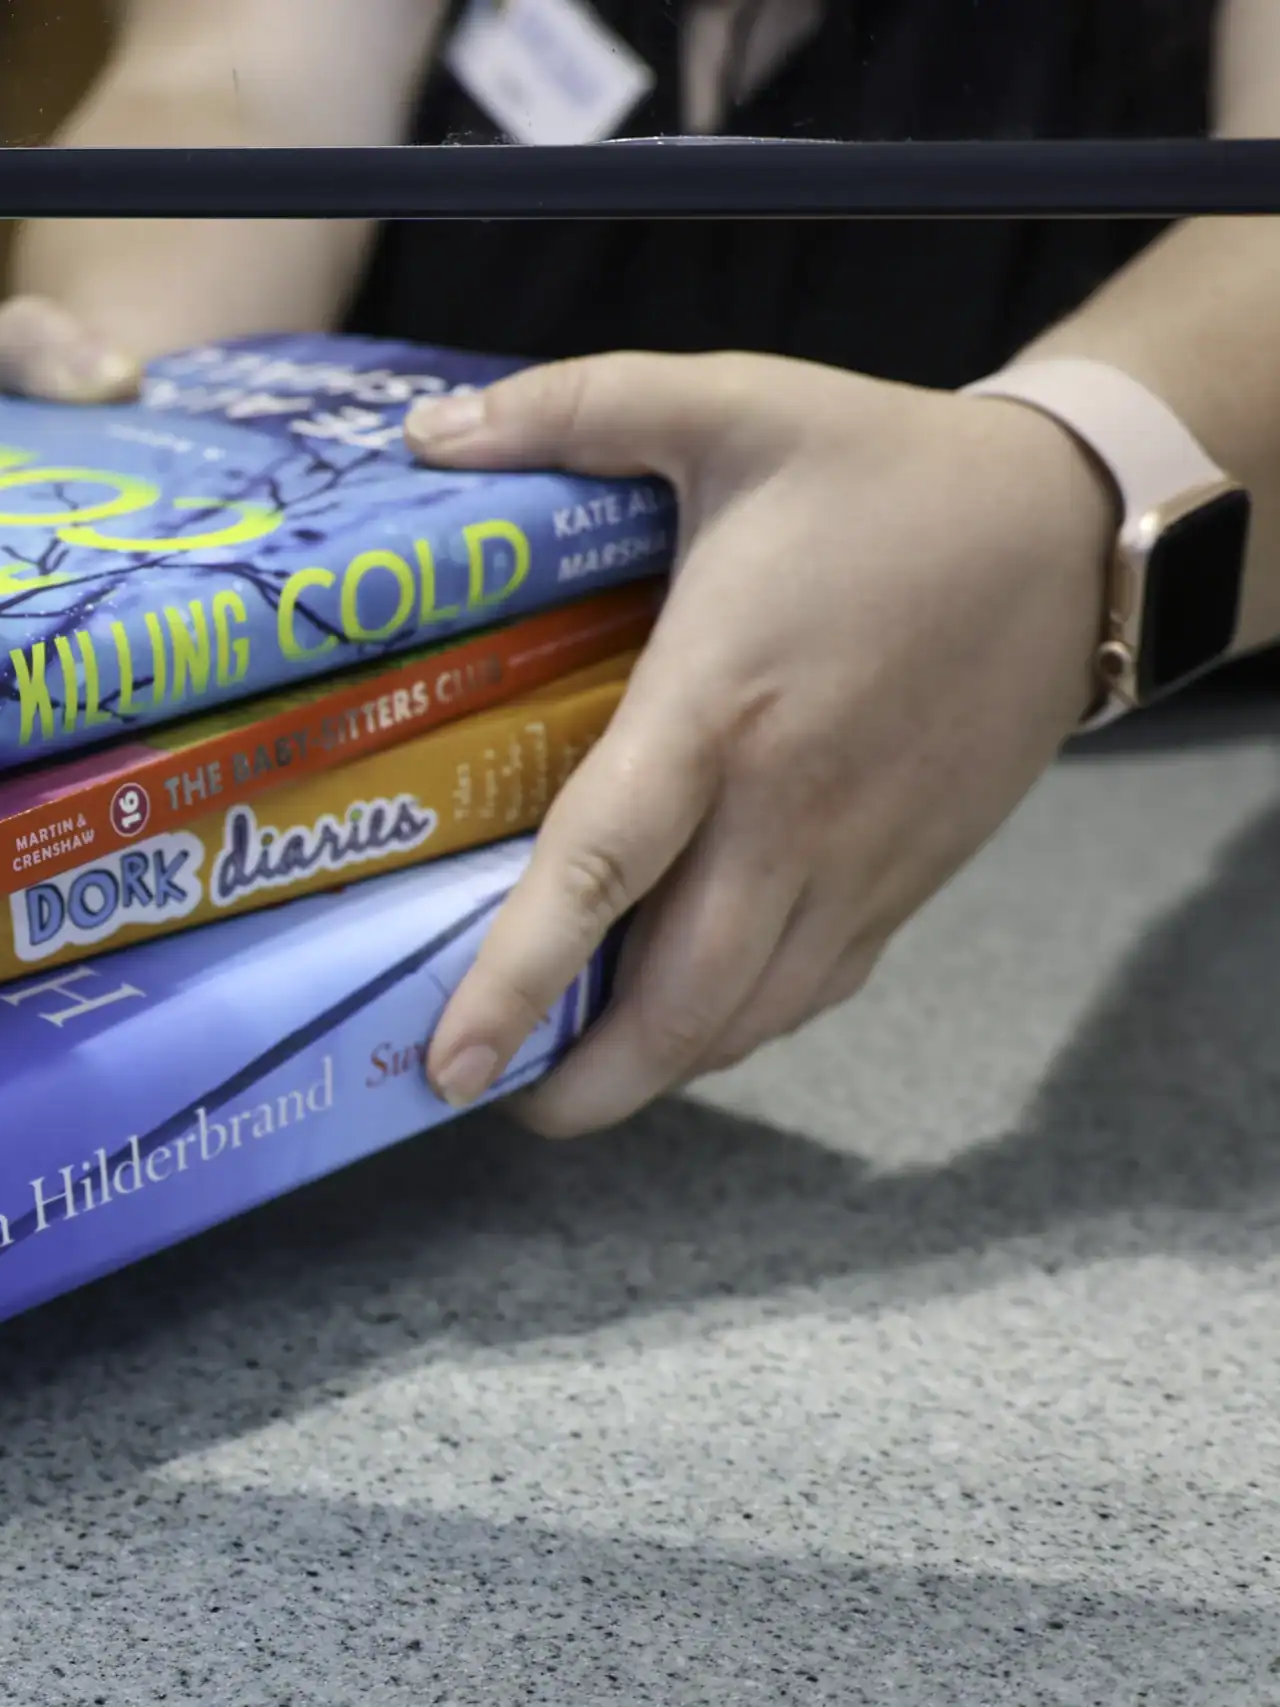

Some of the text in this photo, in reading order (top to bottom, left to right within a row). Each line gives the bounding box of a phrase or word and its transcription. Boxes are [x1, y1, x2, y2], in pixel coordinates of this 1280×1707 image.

[553, 492, 620, 541] KATE
[10, 591, 248, 746] KILLING
[276, 519, 530, 660] COLD
[164, 654, 503, 810] THE BABY-SITTERS CLUB
[12, 829, 95, 872] CRENSHAW
[15, 812, 87, 851] MARTIN &
[118, 790, 142, 829] 16
[25, 801, 431, 947] DORK diaries
[29, 1056, 335, 1233] Hilderbrand
